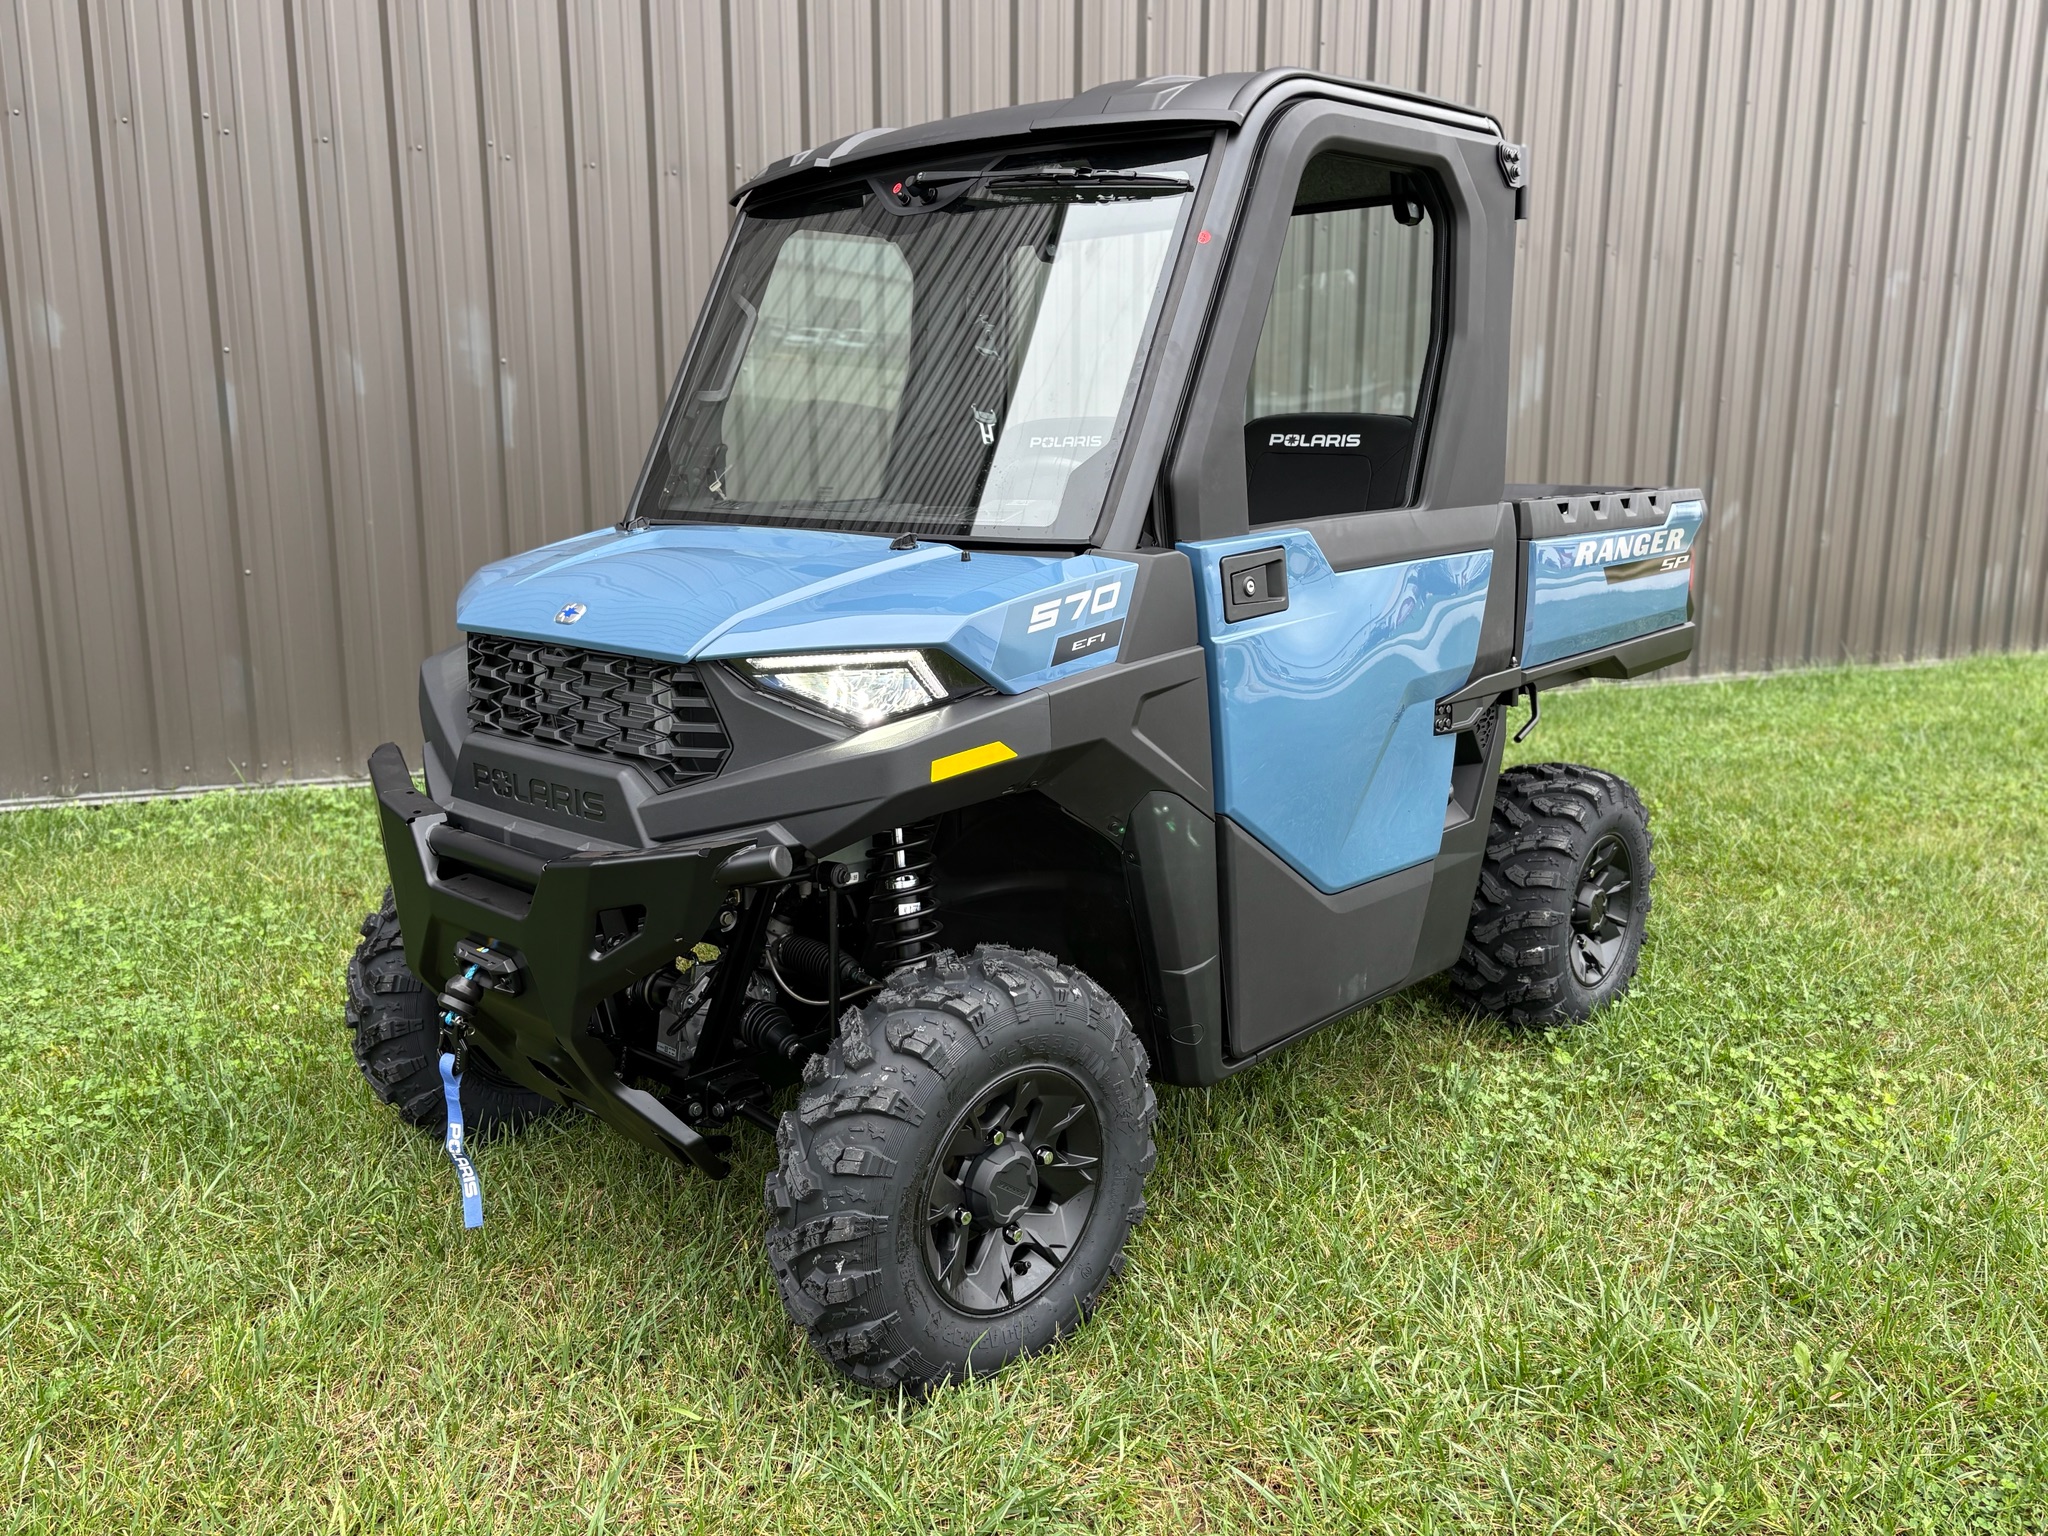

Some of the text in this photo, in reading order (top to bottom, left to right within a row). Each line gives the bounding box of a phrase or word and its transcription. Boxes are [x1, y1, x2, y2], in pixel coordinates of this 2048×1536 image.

[1030, 435, 1102, 448] POLARIS
[1269, 433, 1361, 448] POLARIS
[1574, 528, 1685, 567] RANGER
[1660, 555, 1689, 571] SP
[1027, 581, 1121, 634] 570
[1072, 632, 1106, 651] EFI
[473, 763, 607, 823] POLARIS
[449, 1123, 478, 1198] POLARIS
